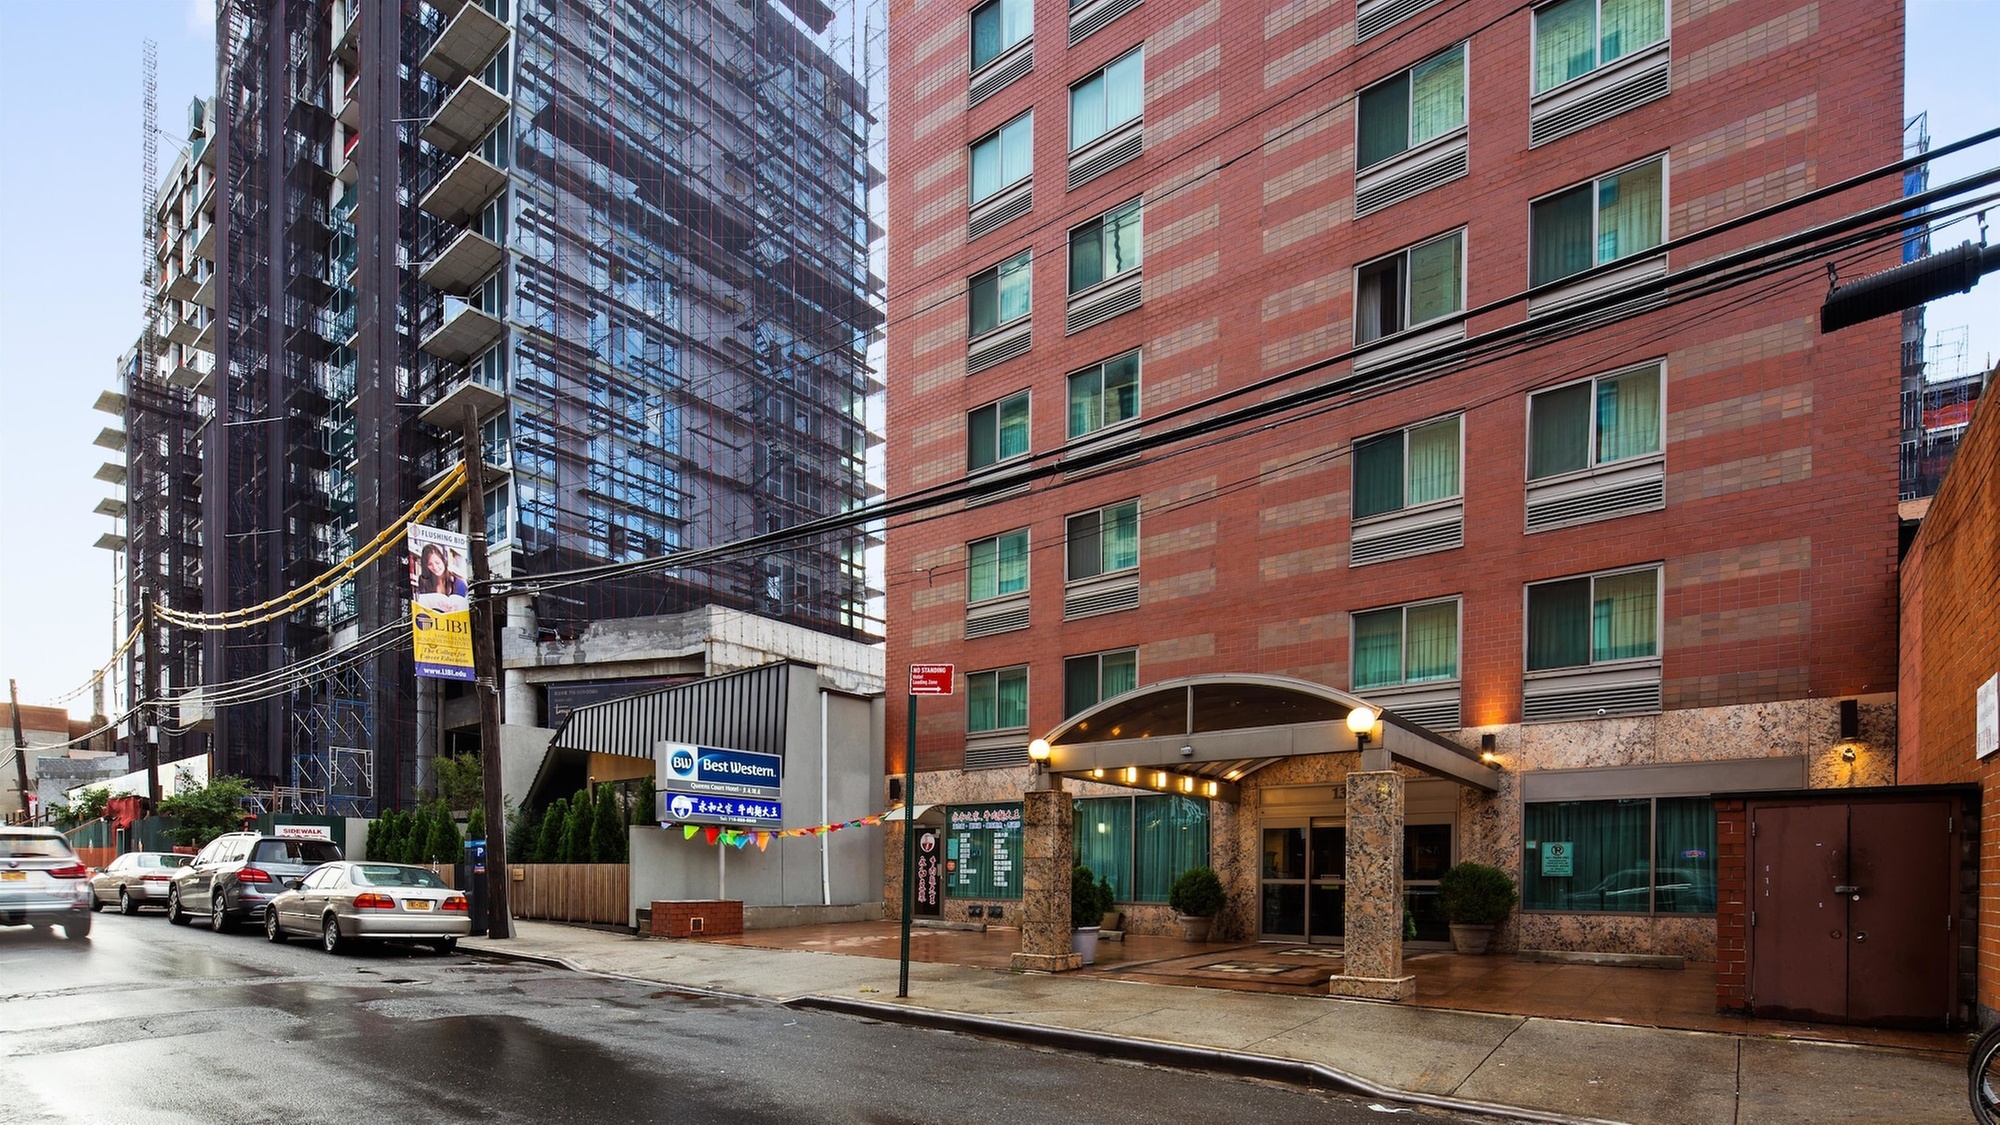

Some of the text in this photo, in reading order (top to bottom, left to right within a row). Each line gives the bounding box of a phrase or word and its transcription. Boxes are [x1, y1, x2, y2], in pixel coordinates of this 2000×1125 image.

[422, 529, 466, 546] FLUSHING BID
[434, 618, 468, 634] LIBI
[419, 653, 469, 663] Career Education
[435, 649, 457, 657] College
[423, 668, 467, 678] www.LIBI.edu
[674, 757, 774, 778] BW Best Western
[699, 800, 733, 814] 永和之家
[477, 847, 484, 857] P
